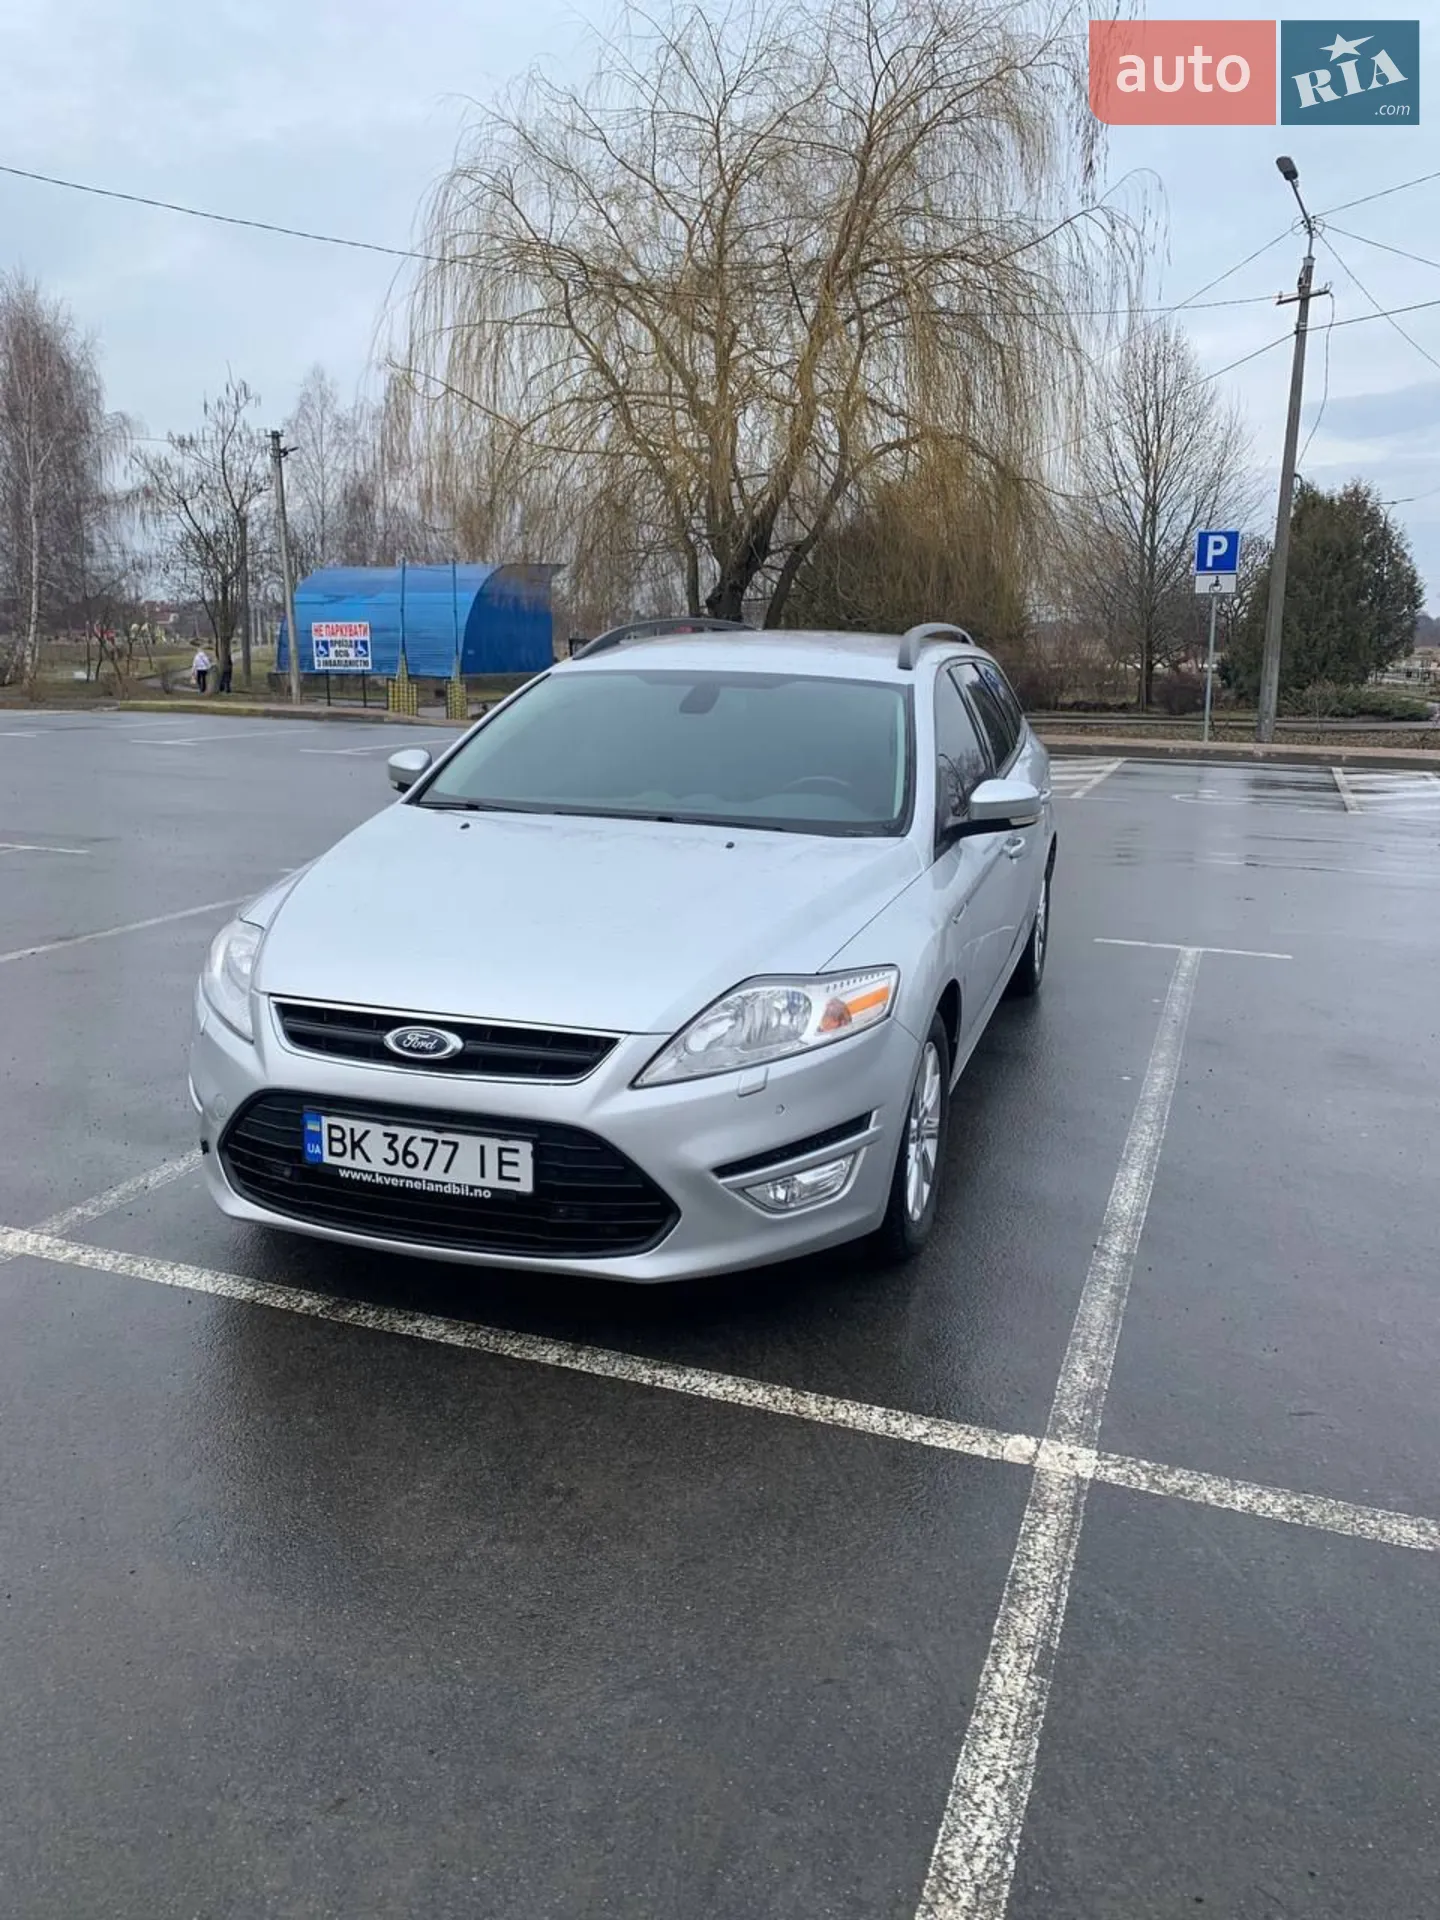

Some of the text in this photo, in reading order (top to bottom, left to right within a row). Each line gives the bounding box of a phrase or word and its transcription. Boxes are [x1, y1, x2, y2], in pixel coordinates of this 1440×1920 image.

[1206, 535, 1228, 568] P
[313, 624, 368, 637] НЕ ПАРКУВАТИ
[402, 1032, 438, 1050] Ford
[307, 1143, 321, 1155] UA
[326, 1123, 521, 1183] BK 3677 IE
[338, 1167, 492, 1199] www.kvernelandbil.no
